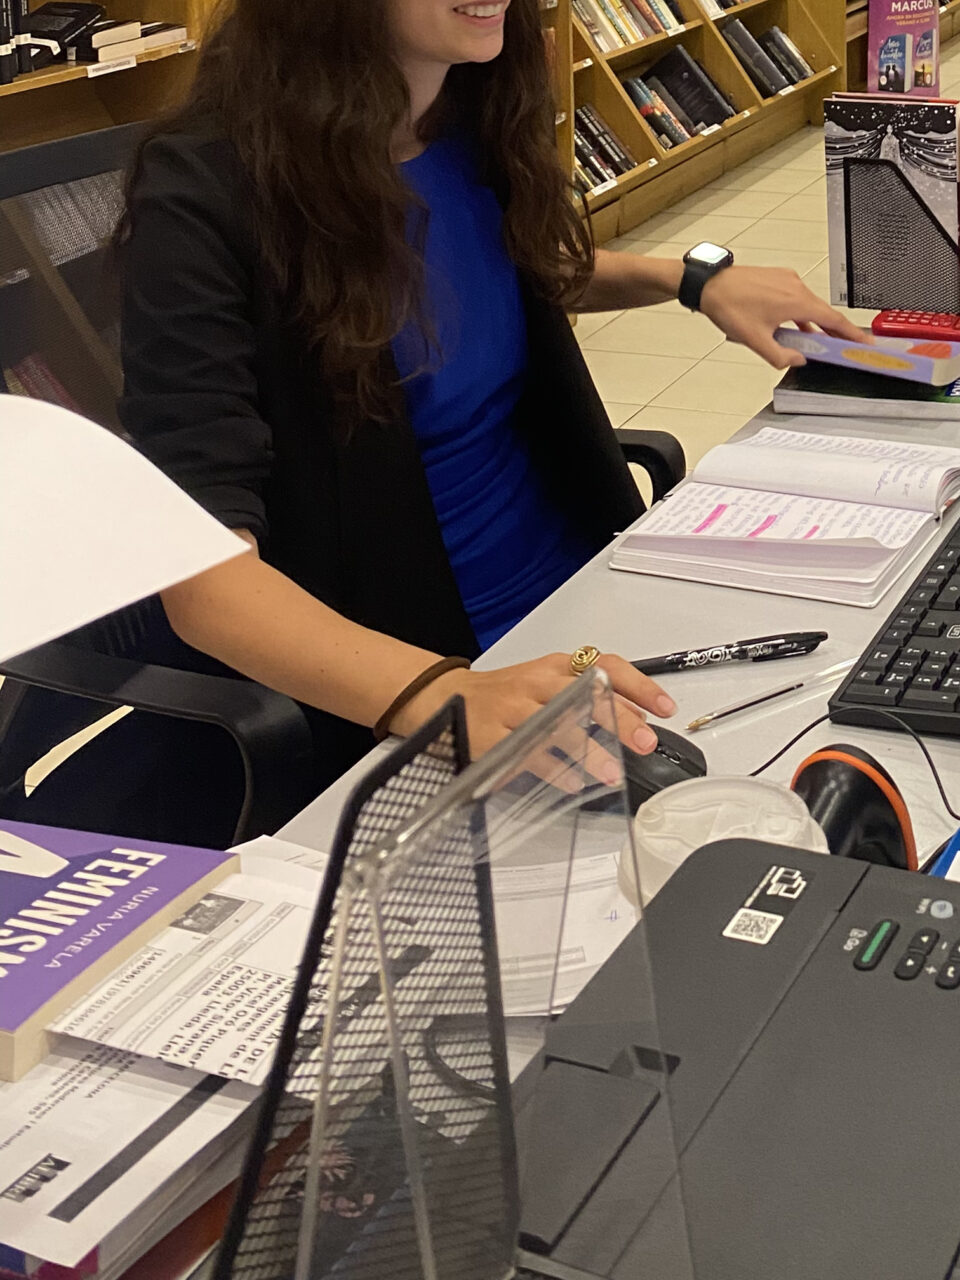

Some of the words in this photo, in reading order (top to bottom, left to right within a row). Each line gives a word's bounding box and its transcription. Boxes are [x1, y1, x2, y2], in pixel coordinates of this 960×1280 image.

[107, 886, 159, 920] NURIA
[44, 922, 113, 968] VARELA
[202, 964, 244, 997] España
[217, 968, 257, 999] 25003,
[249, 976, 287, 1010] Maricel
[179, 999, 222, 1031] Lleida,
[228, 1009, 249, 1027] Oró
[173, 1014, 224, 1058] Siurana,
[187, 1028, 228, 1067] Piquer
[229, 1044, 247, 1059] de
[243, 1048, 265, 1065] DE
[35, 1085, 80, 1120] Modernes
